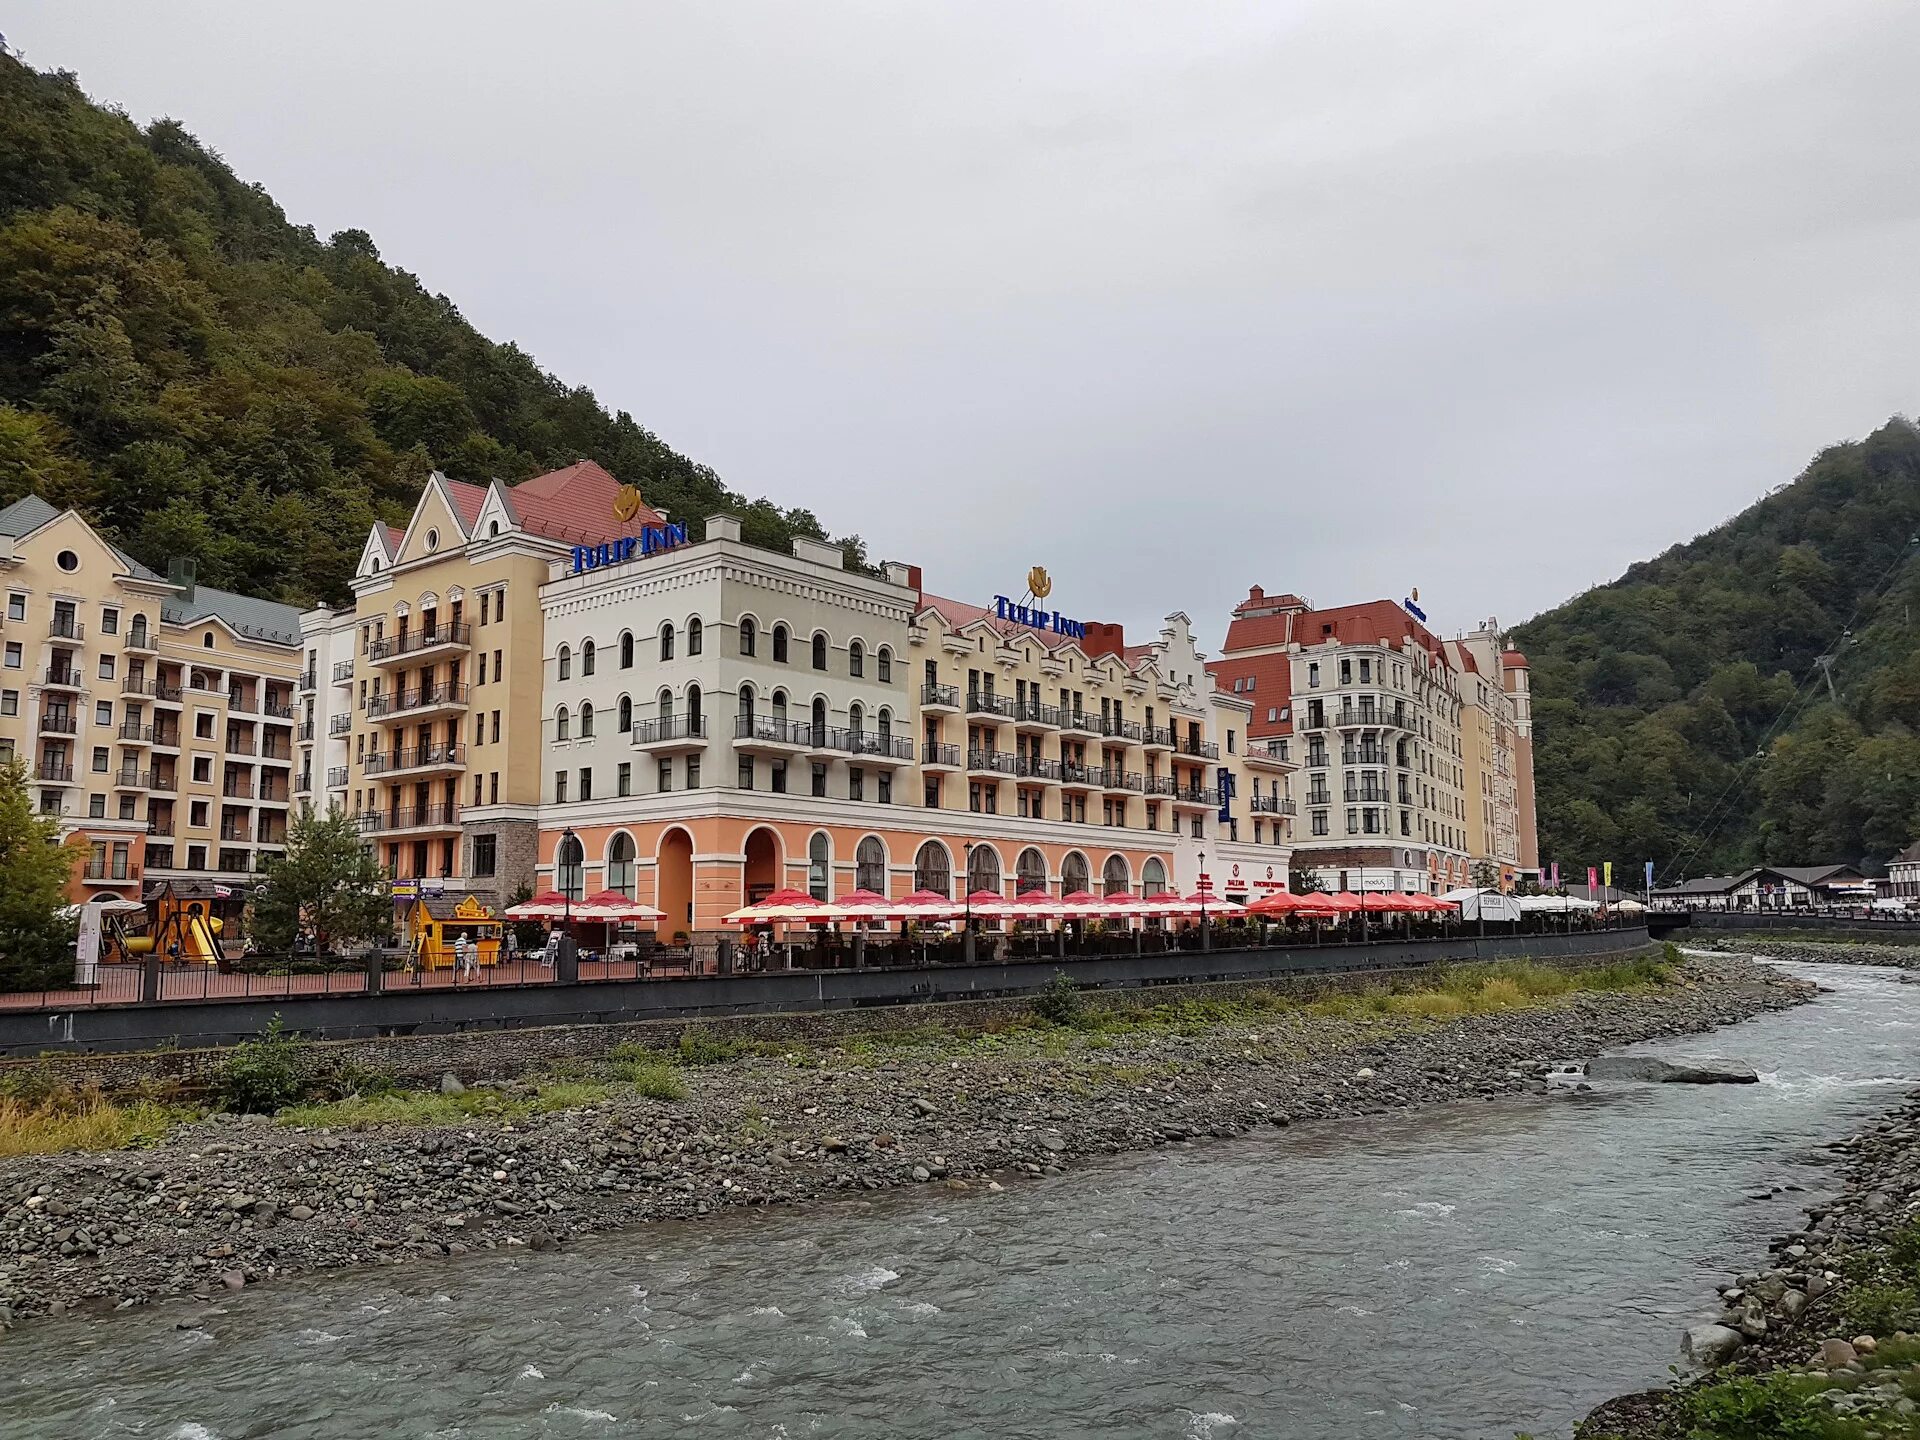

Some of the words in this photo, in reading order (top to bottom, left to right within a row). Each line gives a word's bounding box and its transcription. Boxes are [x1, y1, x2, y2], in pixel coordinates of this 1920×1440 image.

[570, 536, 637, 573] TULIP
[641, 519, 687, 555] INN
[994, 595, 1050, 630] TULIP
[1052, 611, 1086, 640] INN
